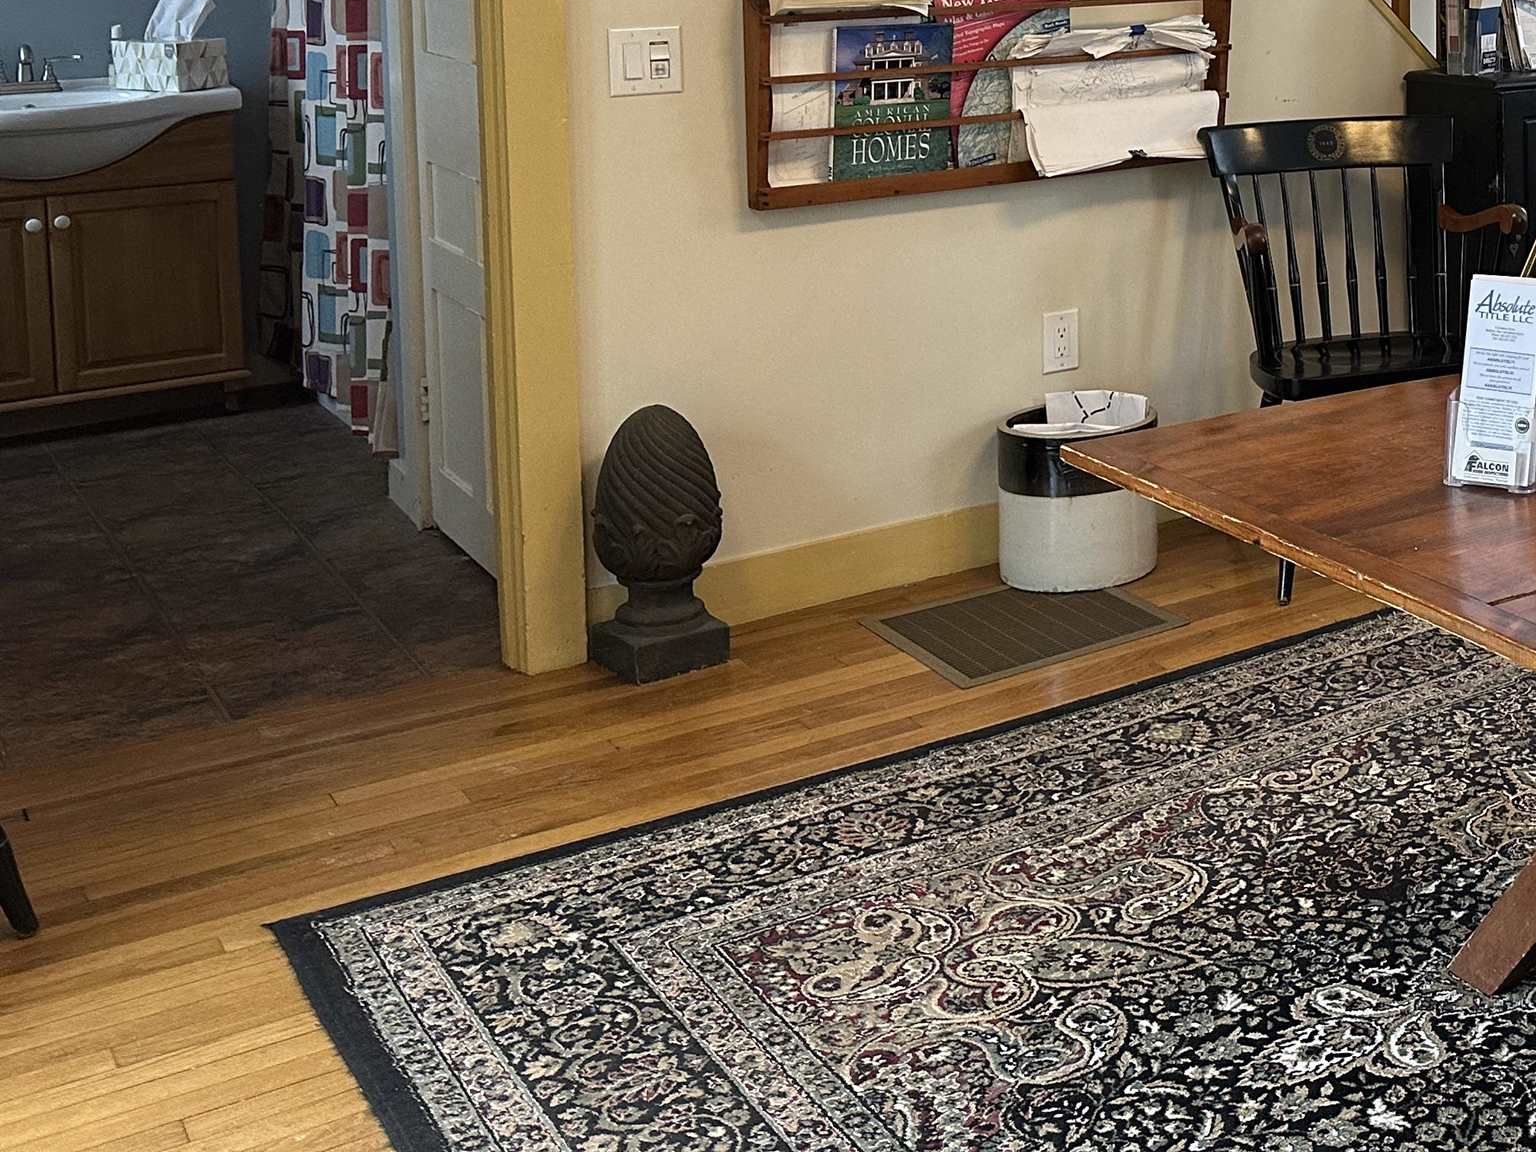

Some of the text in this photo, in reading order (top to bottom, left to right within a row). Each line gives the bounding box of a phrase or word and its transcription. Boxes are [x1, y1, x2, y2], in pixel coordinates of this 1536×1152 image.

[855, 104, 931, 118] AMERICAN
[851, 132, 931, 166] HOMES
[1475, 289, 1536, 315] Absolute
[1478, 311, 1534, 325] TITLE LLC
[1470, 461, 1509, 472] FALCON
